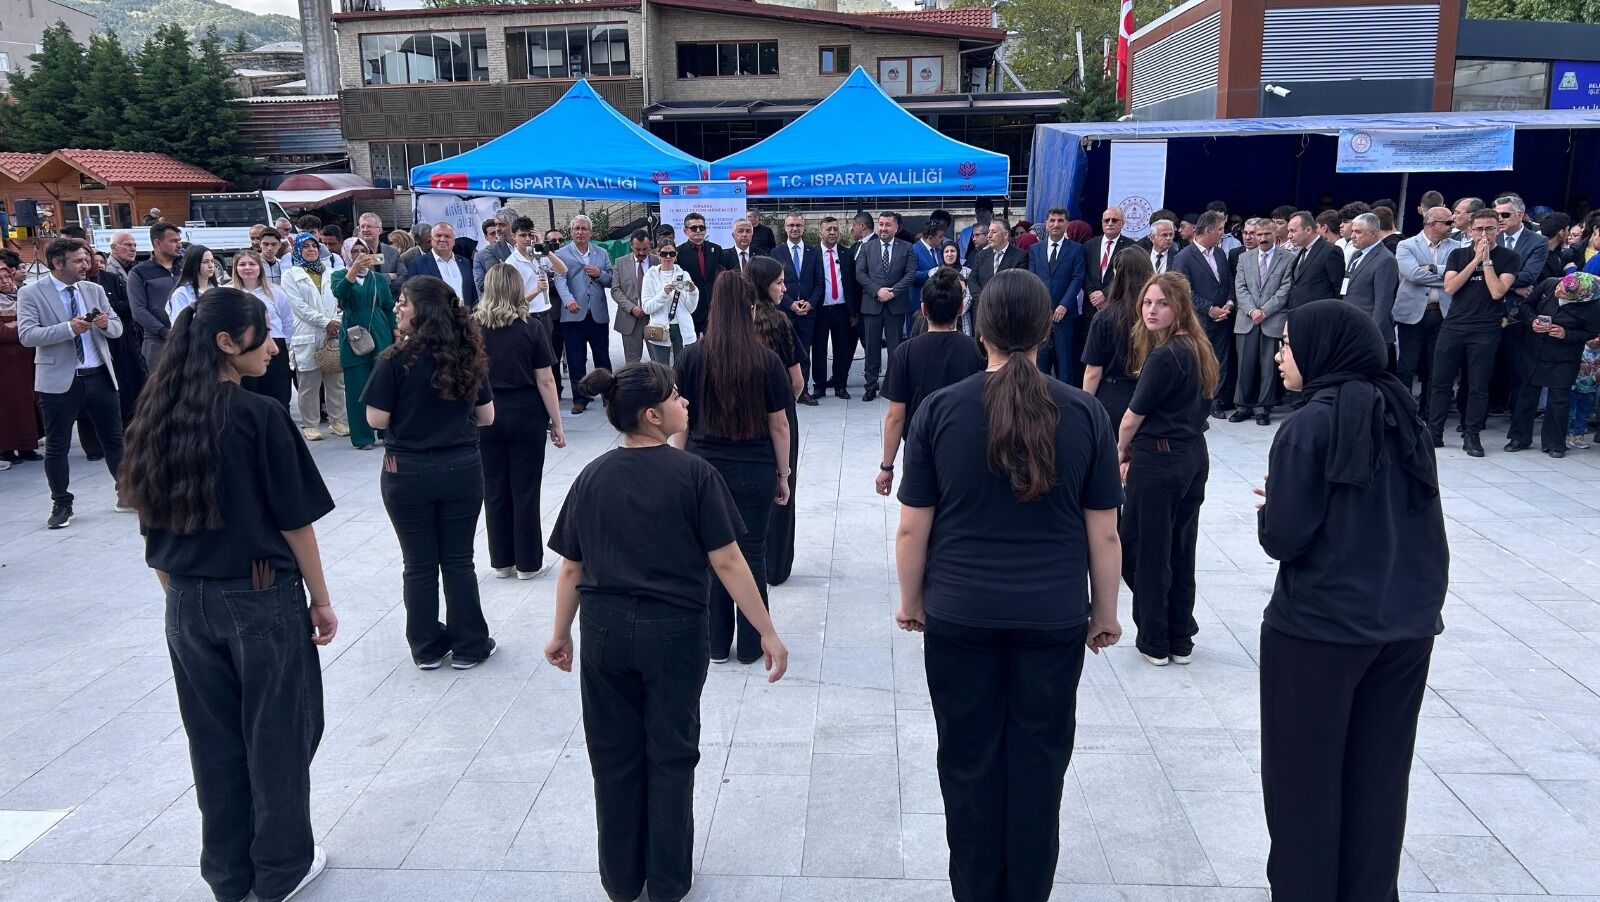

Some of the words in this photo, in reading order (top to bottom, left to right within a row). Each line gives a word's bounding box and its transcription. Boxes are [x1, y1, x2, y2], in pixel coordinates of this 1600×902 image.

[480, 179, 505, 191] T.C.
[510, 176, 573, 190] ISPARTA
[576, 176, 637, 190] VALİLİĞİ
[779, 175, 806, 188] T.C.
[810, 172, 875, 187] ISPARTA
[878, 167, 943, 185] VALİLİĞİ
